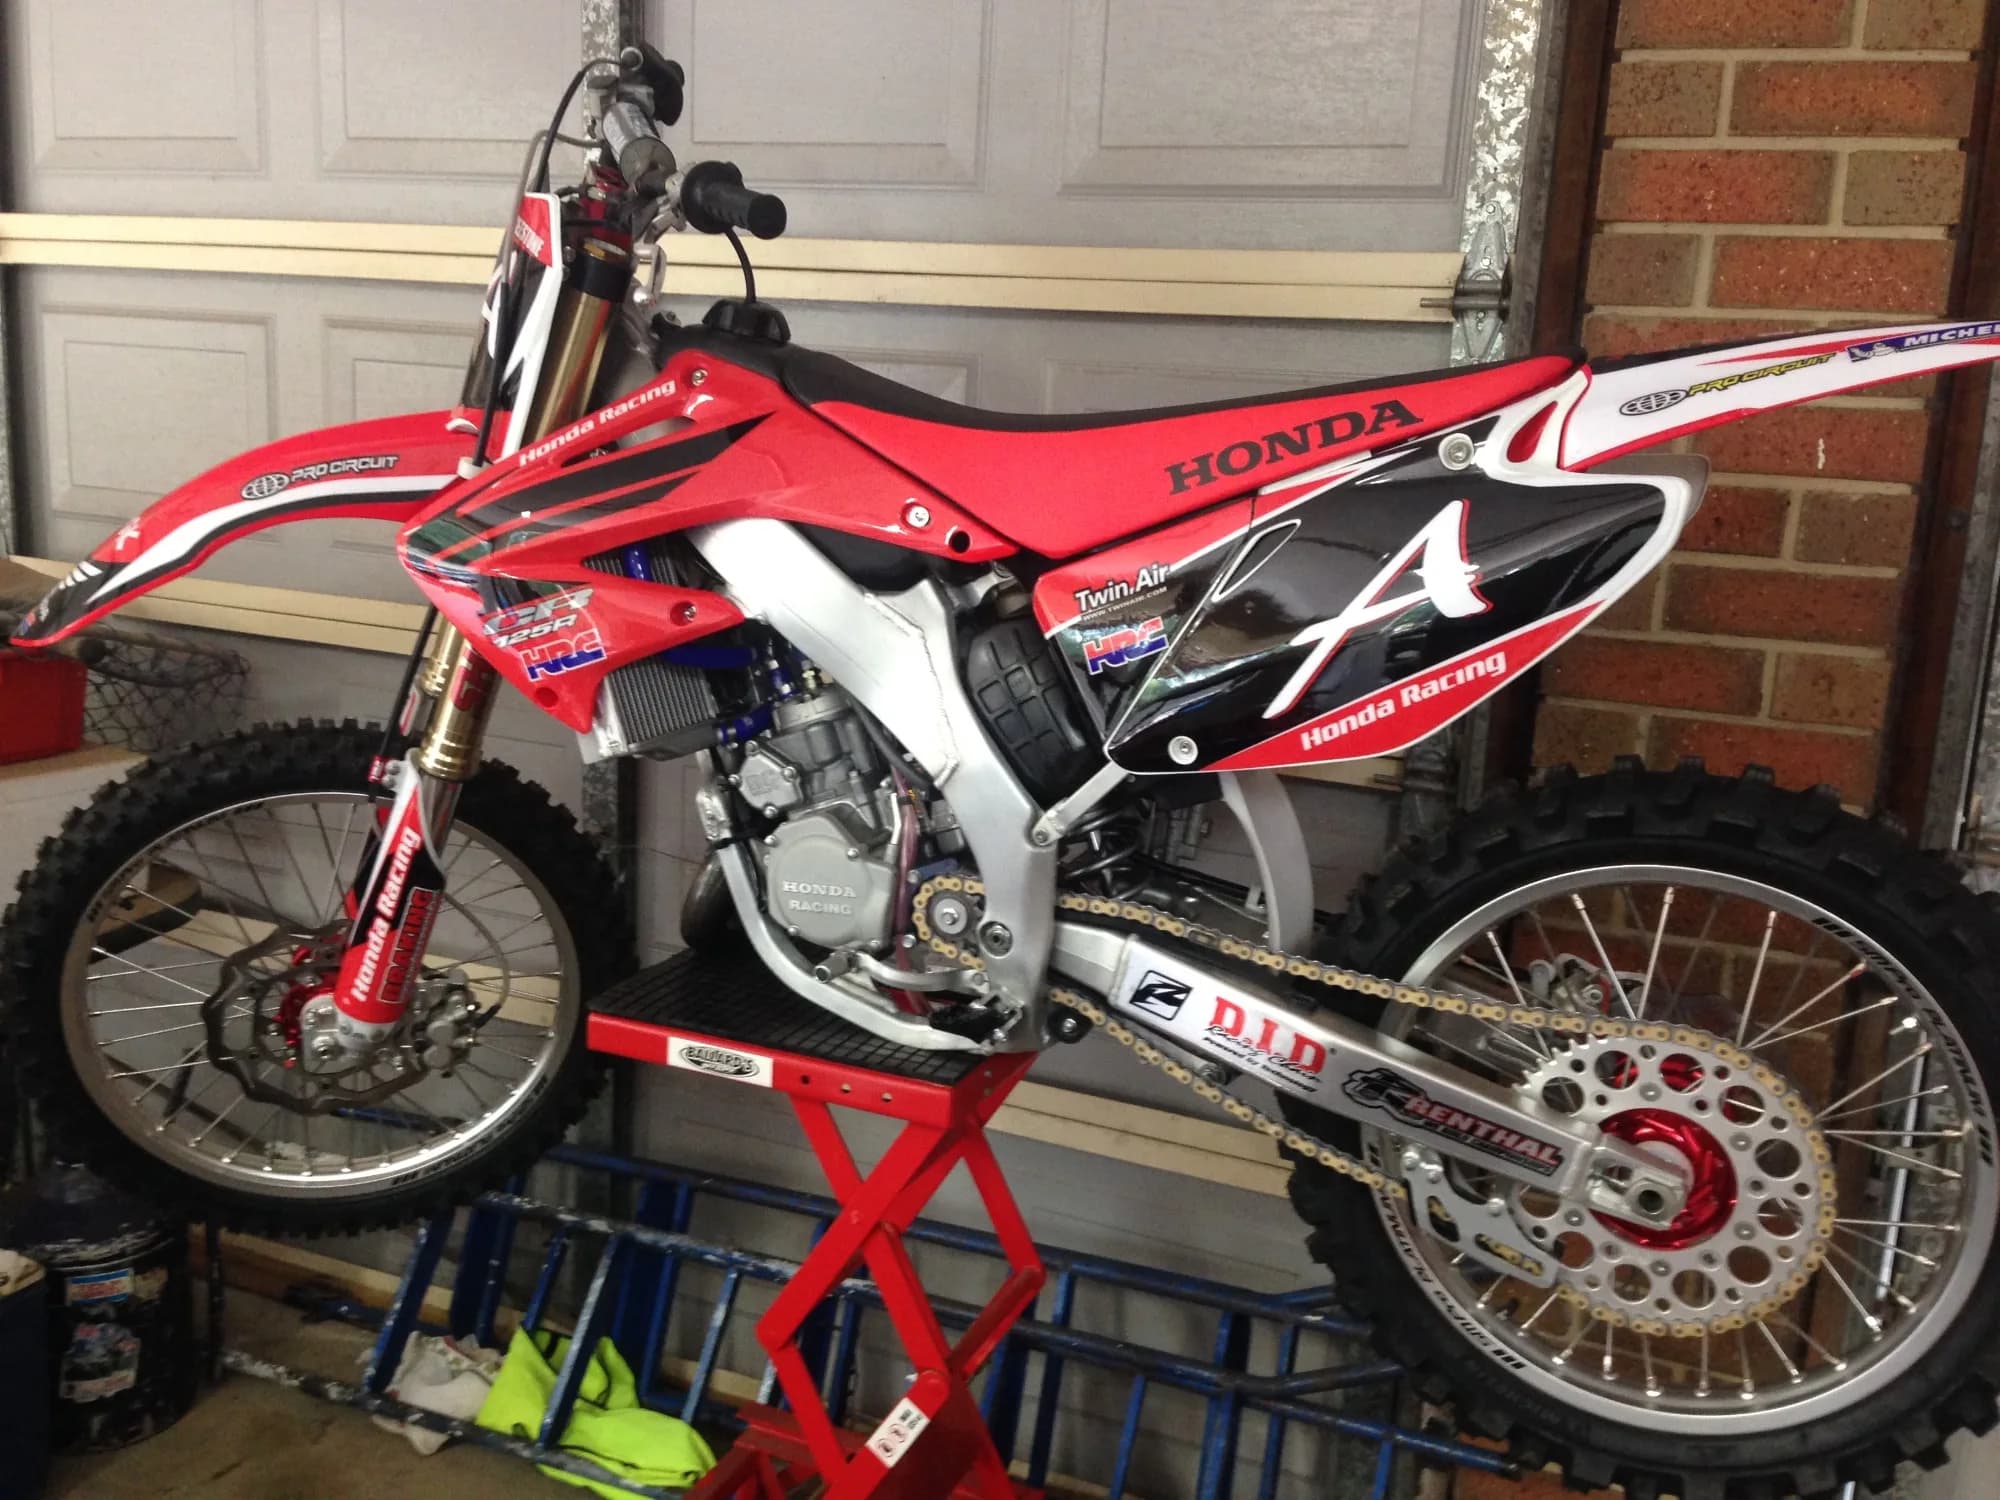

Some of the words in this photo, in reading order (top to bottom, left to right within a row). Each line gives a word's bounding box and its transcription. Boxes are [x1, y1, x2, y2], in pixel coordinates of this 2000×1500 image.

[1688, 375, 1740, 396] PRO
[1741, 352, 1836, 381] CIRCUIT
[519, 420, 595, 467] Honda
[600, 380, 677, 424] Racing
[1165, 400, 1424, 495] HONDA
[289, 463, 330, 483] PRO
[328, 454, 400, 474] CIRCUIT
[494, 614, 578, 648] 125R
[520, 627, 608, 682] HRC
[1082, 616, 1169, 675] HRC
[1300, 699, 1396, 751] Honda
[1400, 651, 1507, 708] Racing
[351, 916, 391, 1002] Honda
[376, 826, 421, 920] Racing
[782, 881, 857, 898] HONDA
[788, 899, 852, 915] RACING
[1403, 1095, 1563, 1166] RENTHAL
